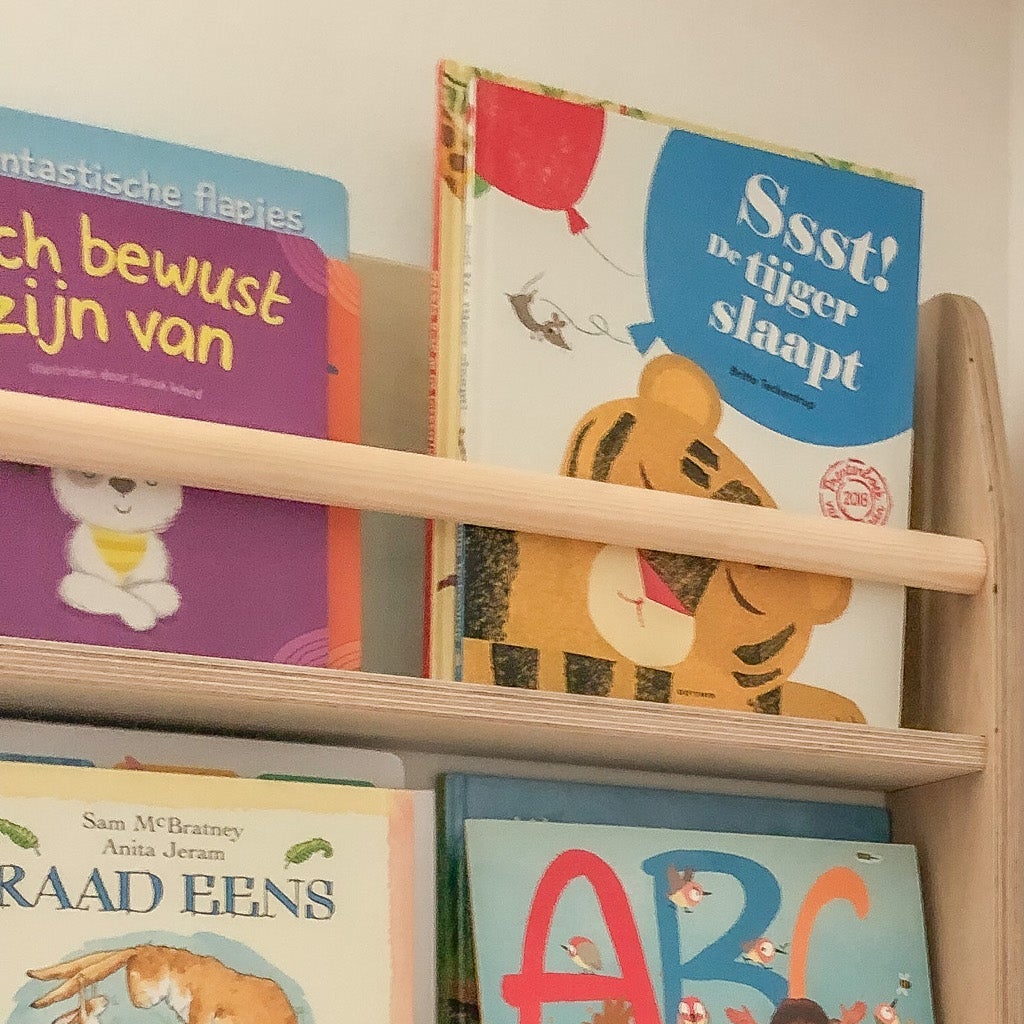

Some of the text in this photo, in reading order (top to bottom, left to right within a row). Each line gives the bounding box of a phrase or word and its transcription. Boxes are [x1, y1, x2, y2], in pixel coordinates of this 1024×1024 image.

[80, 211, 291, 325] bewust
[736, 173, 898, 292] Ssst!
[0, 277, 233, 371] zijn van
[707, 233, 859, 326] De tijger
[708, 295, 863, 391] slaapt
[82, 811, 244, 842] Sam McBratney
[102, 838, 225, 861] Anita Jeram
[0, 864, 336, 920] RAAD EENS
